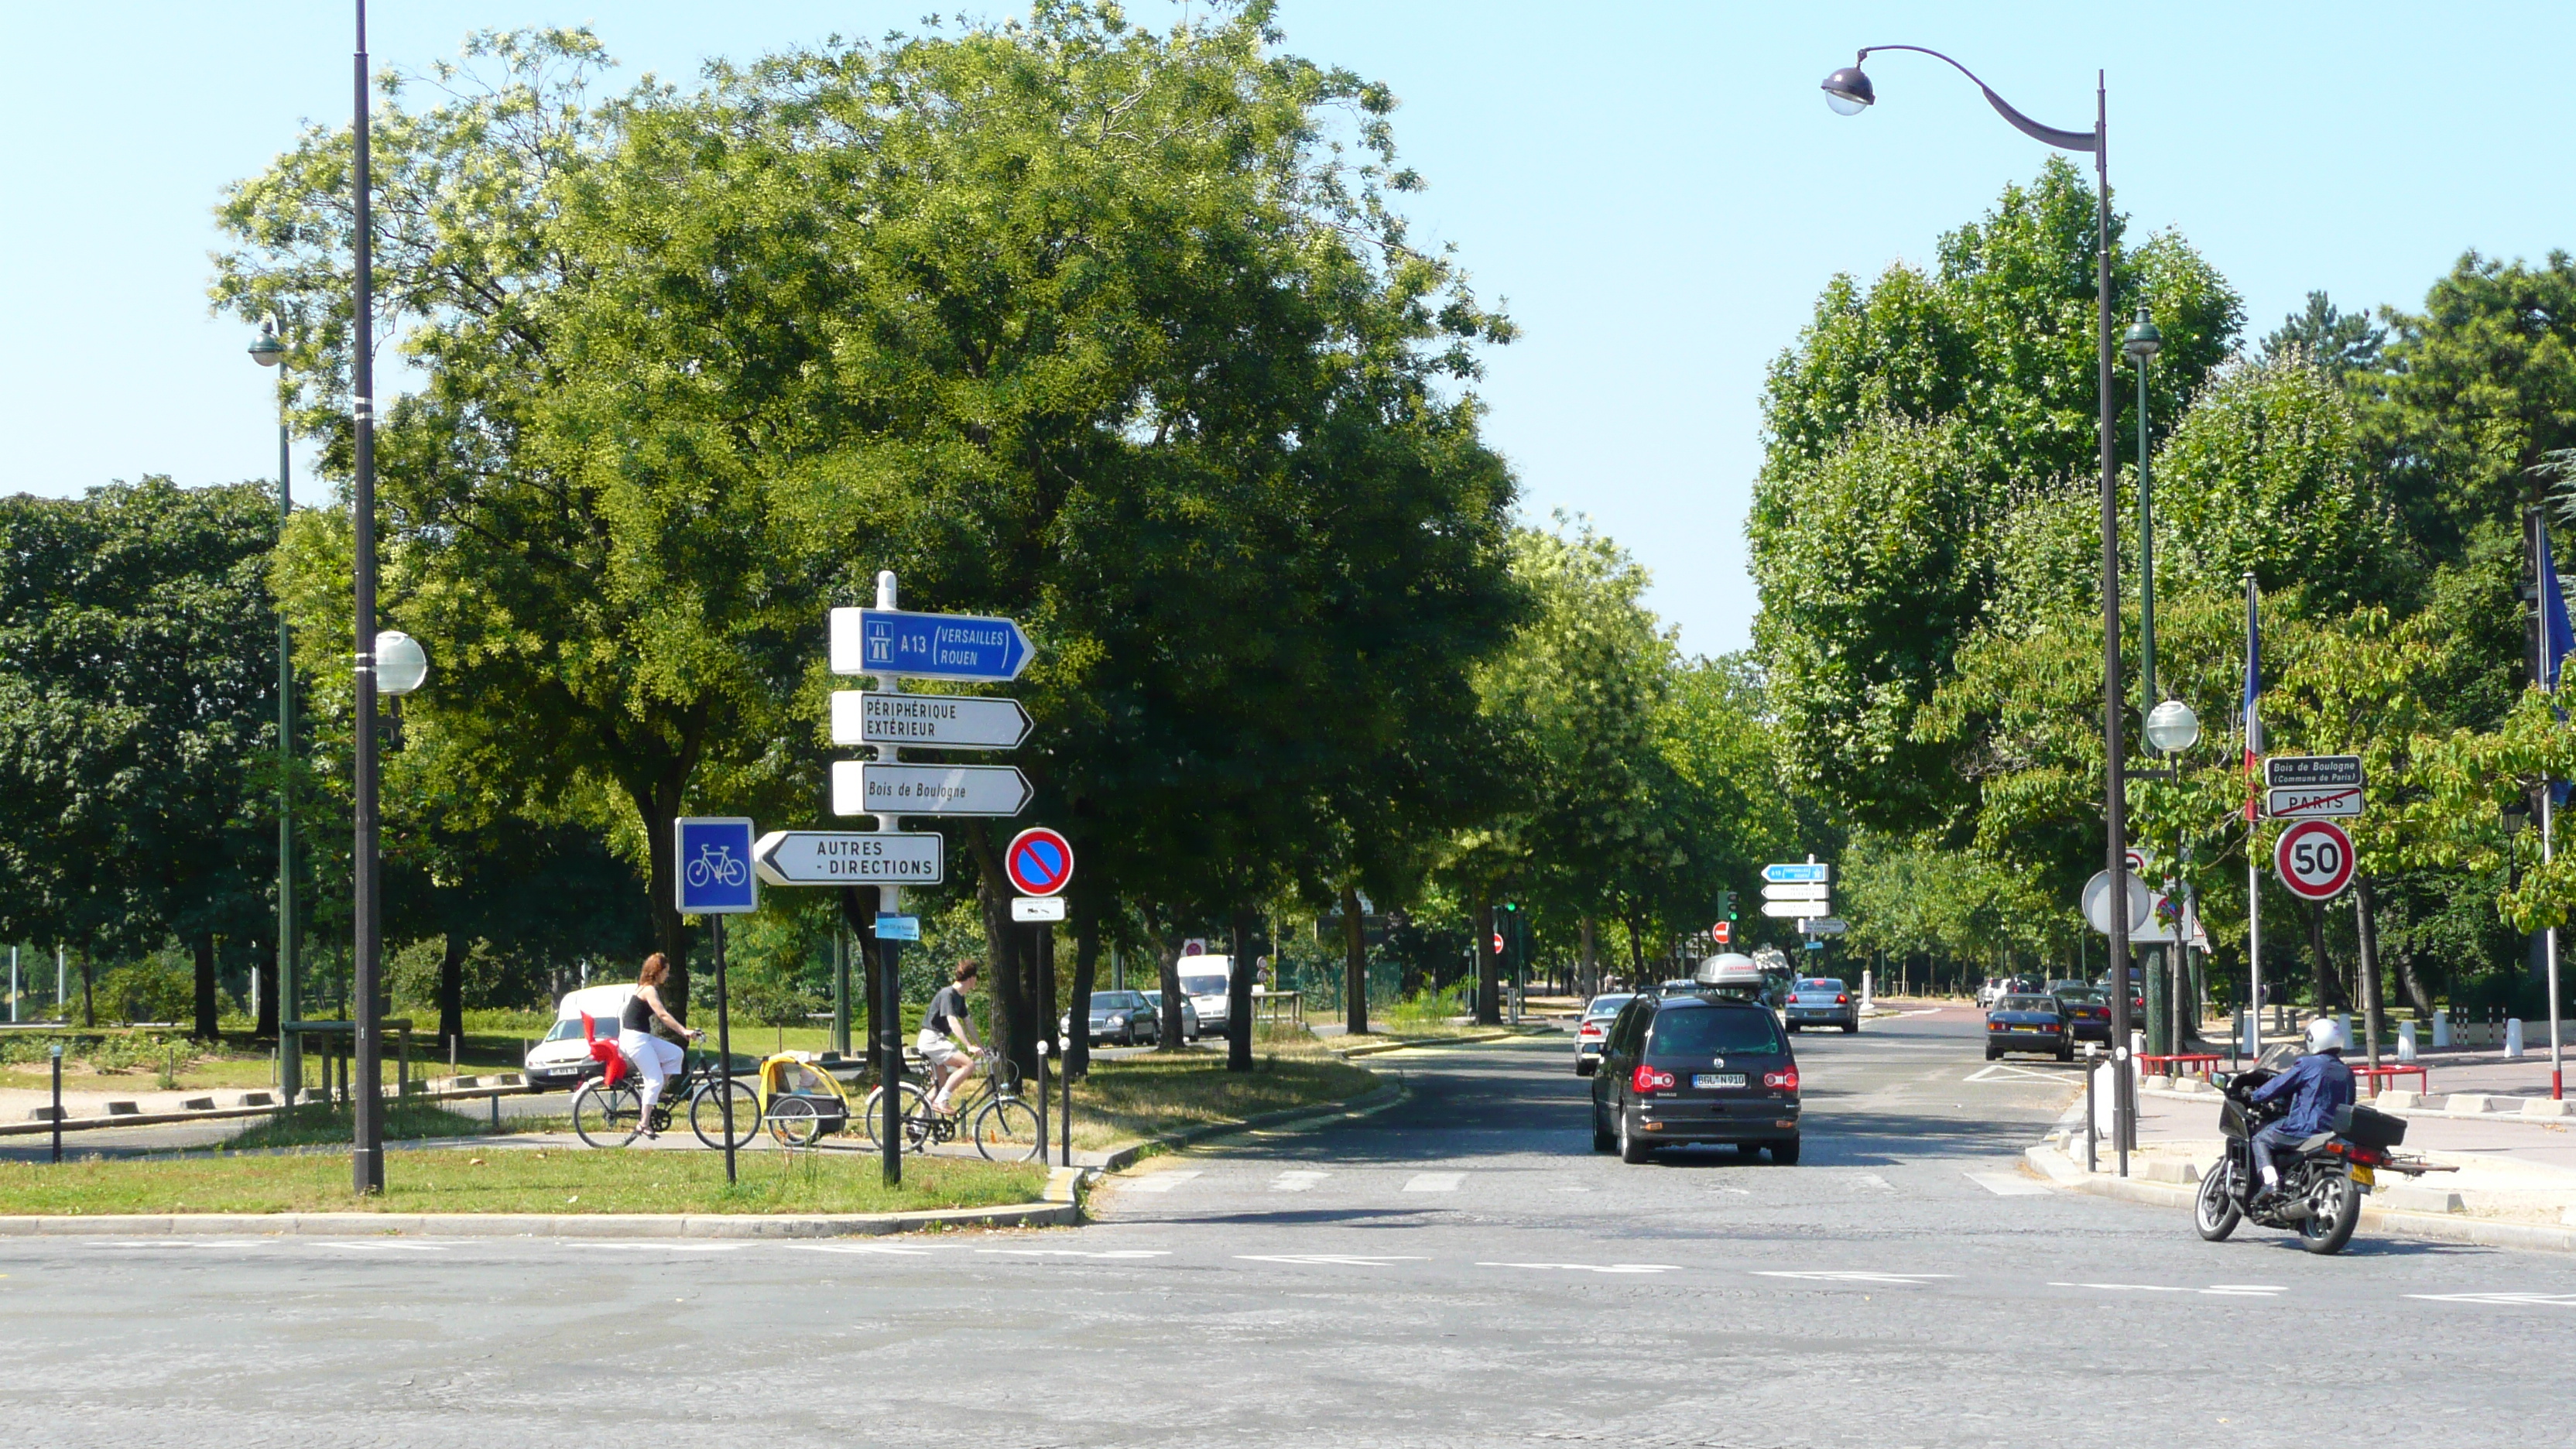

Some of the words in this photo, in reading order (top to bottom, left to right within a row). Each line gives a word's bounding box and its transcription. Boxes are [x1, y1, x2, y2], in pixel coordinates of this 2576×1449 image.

[900, 635, 909, 652] A
[912, 635, 927, 653] 13
[940, 628, 1004, 646] VERSAILLES
[940, 649, 978, 666] ROUEN
[867, 699, 957, 719] PÉRIPHÉRIQUE
[867, 718, 935, 736] EXTÉRIEUR
[2273, 762, 2293, 772] Bois
[2297, 762, 2309, 772] de
[2313, 761, 2355, 773] Boulogne
[2273, 775, 2317, 783] (Commune
[2331, 773, 2355, 782] Paris)
[868, 781, 892, 796] Bois
[898, 782, 910, 797] de
[916, 783, 966, 801] Boulogne
[2289, 796, 2344, 810] PARIS
[817, 841, 882, 855] AUTRES
[2294, 842, 2338, 875] 50
[830, 860, 932, 875] DIRECTIONS
[1698, 1075, 1715, 1084] BGL
